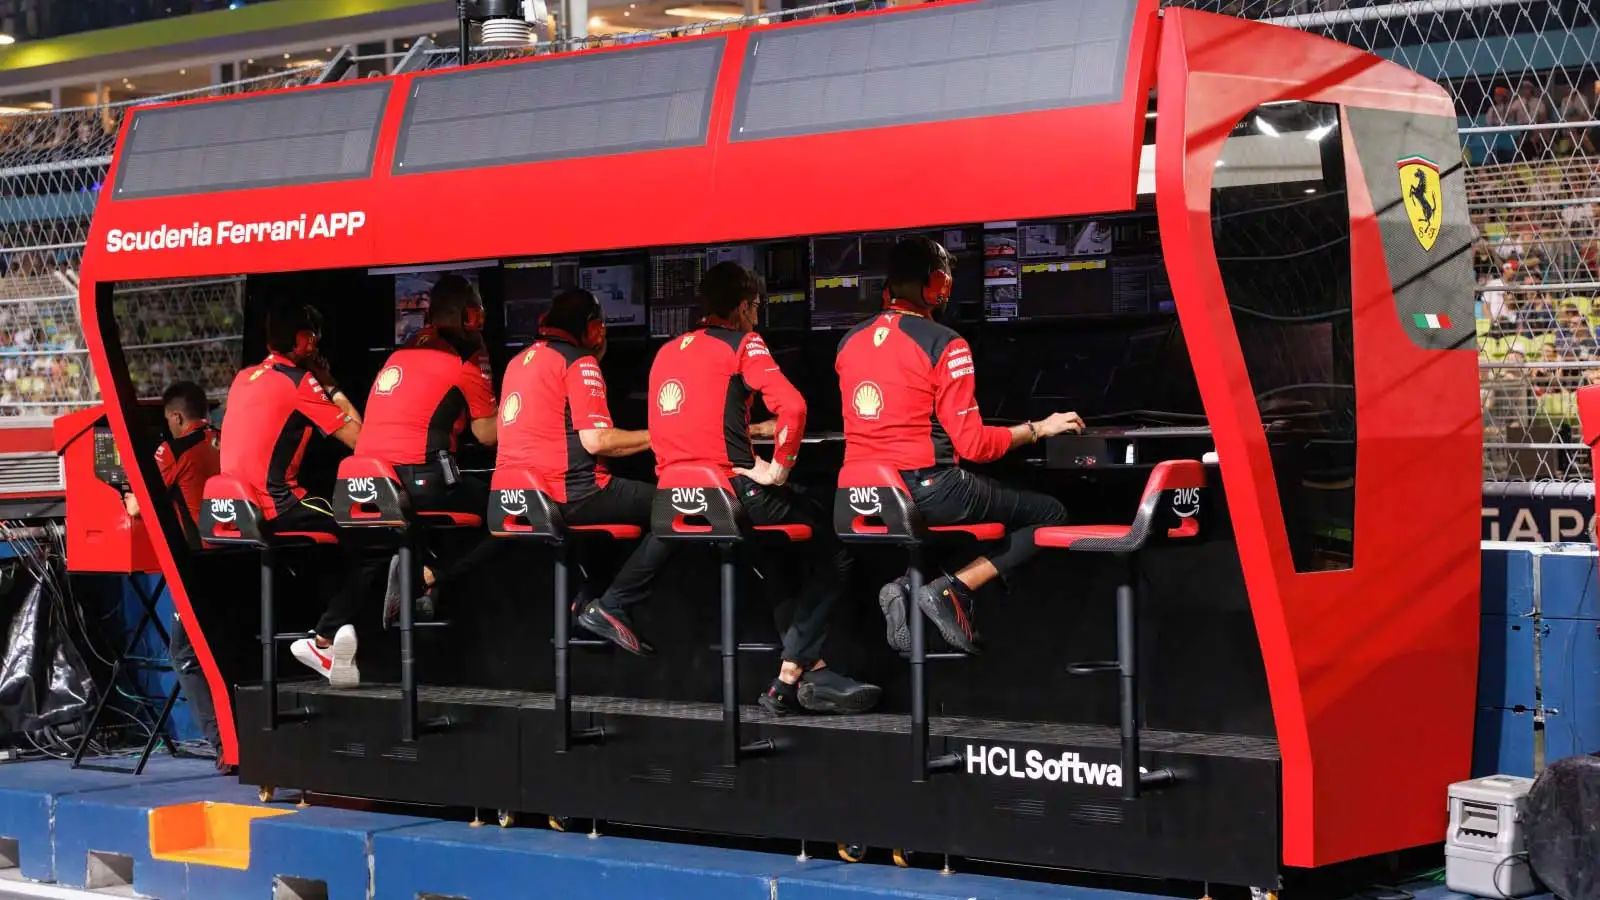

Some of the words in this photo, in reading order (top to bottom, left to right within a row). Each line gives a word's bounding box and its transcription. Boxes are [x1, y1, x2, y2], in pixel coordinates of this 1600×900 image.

[106, 222, 212, 252] Scuderia
[216, 213, 307, 245] Ferrari
[308, 211, 366, 239] APP
[347, 476, 376, 492] aws
[500, 489, 526, 504] aws
[671, 487, 706, 503] aws
[849, 487, 880, 503] aws
[1173, 488, 1200, 505] aws
[210, 498, 235, 512] aws
[1481, 508, 1598, 541] AP
[966, 744, 1148, 788] HCLSoftwa
